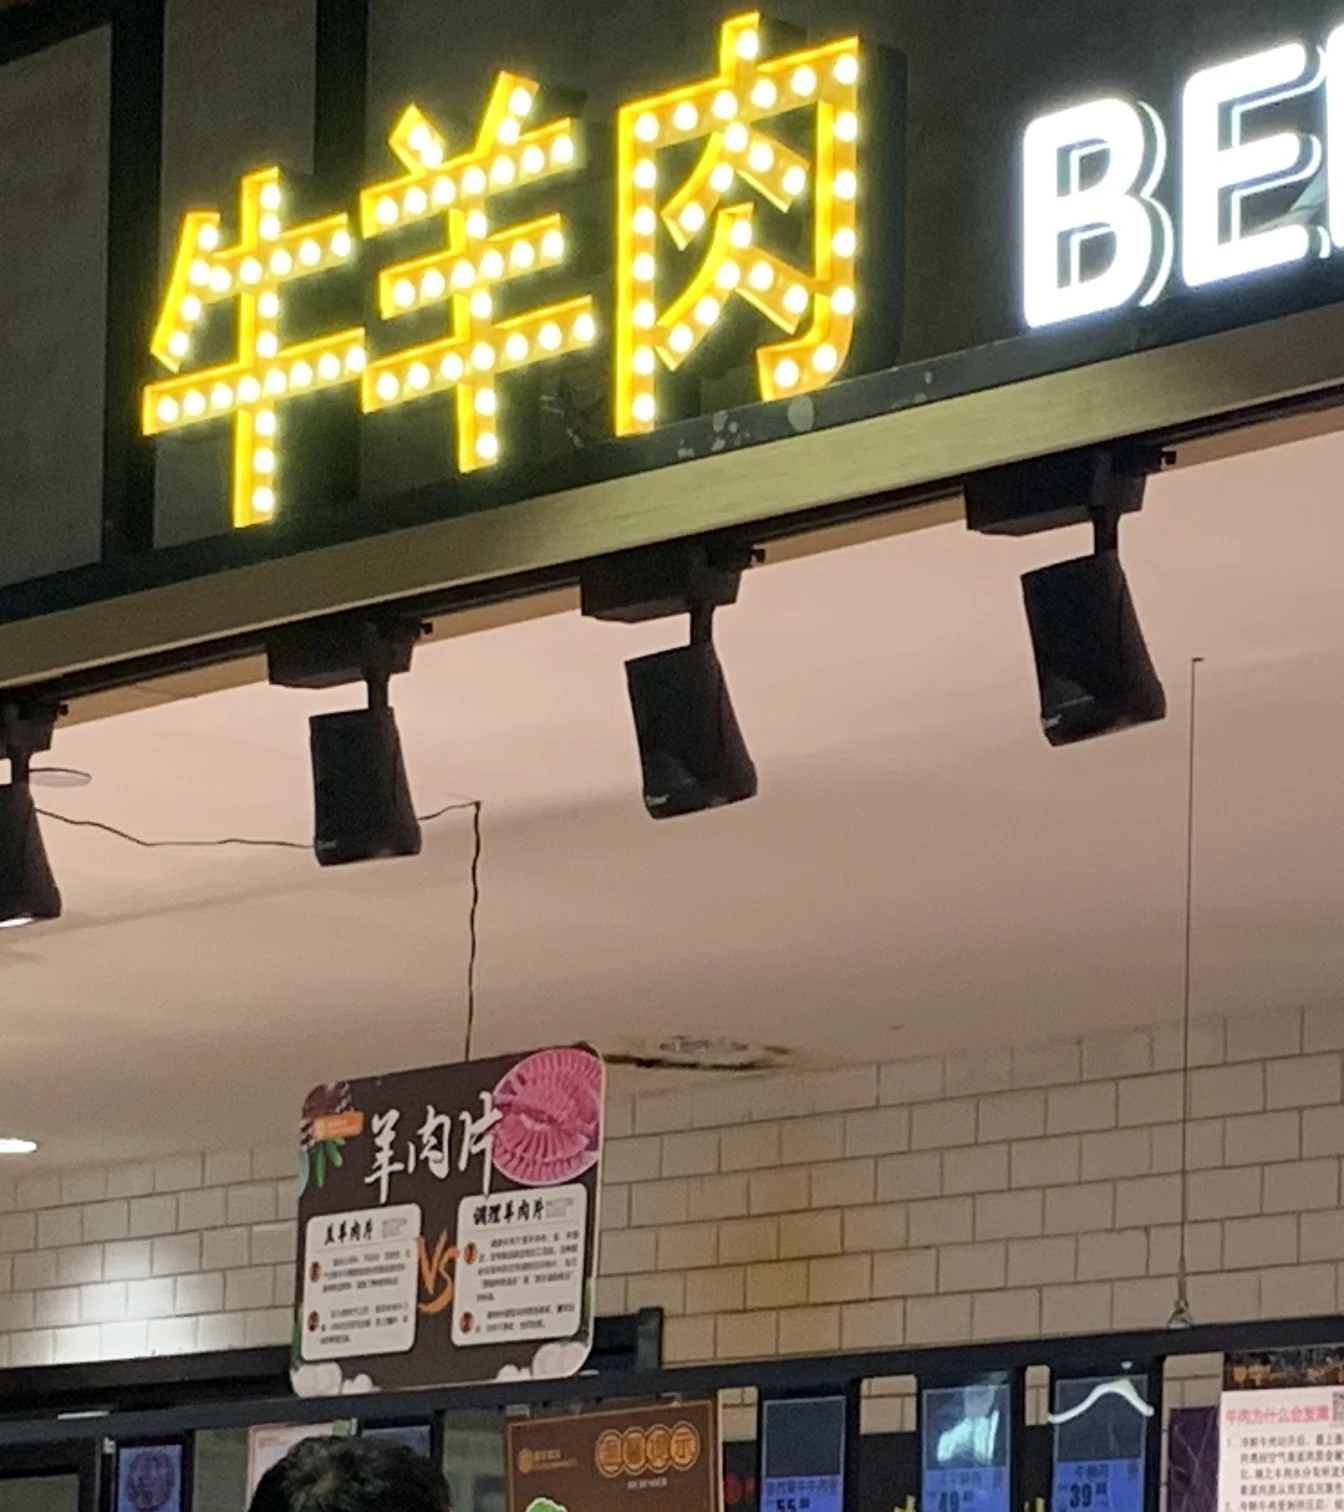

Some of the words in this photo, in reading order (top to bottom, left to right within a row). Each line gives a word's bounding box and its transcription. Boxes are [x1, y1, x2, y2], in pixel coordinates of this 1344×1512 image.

[142, 11, 859, 528] 牛羊肉
[364, 1090, 504, 1205] 羊肉片
